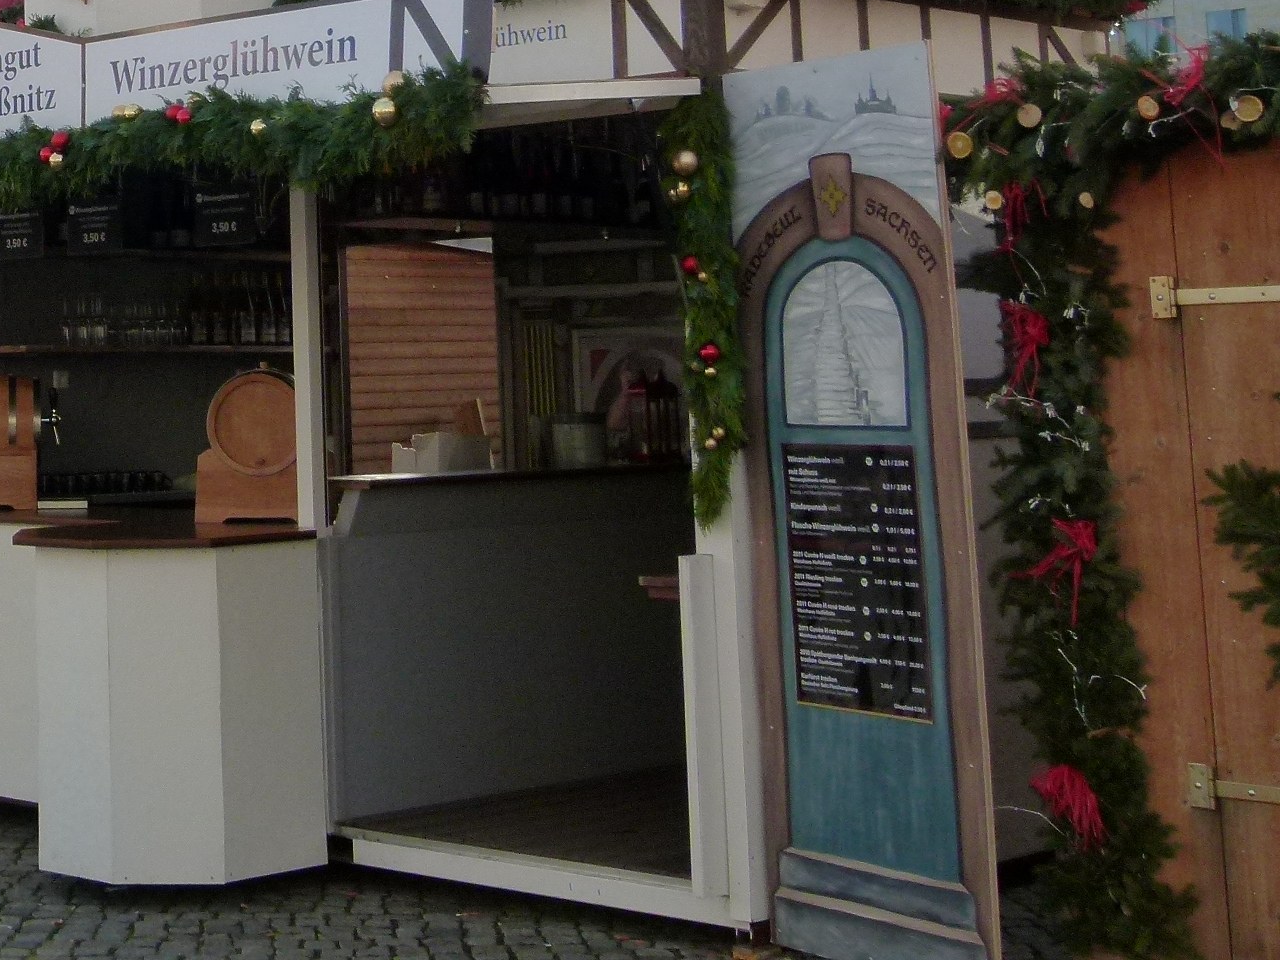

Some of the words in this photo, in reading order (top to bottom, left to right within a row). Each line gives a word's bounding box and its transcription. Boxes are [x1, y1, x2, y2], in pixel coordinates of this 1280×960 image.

[495, 20, 567, 48] ühwein
[109, 27, 358, 90] Winzerglühwein
[211, 221, 229, 234] 3,50
[864, 197, 938, 273] SACHSEN
[6, 238, 20, 249] 3,50
